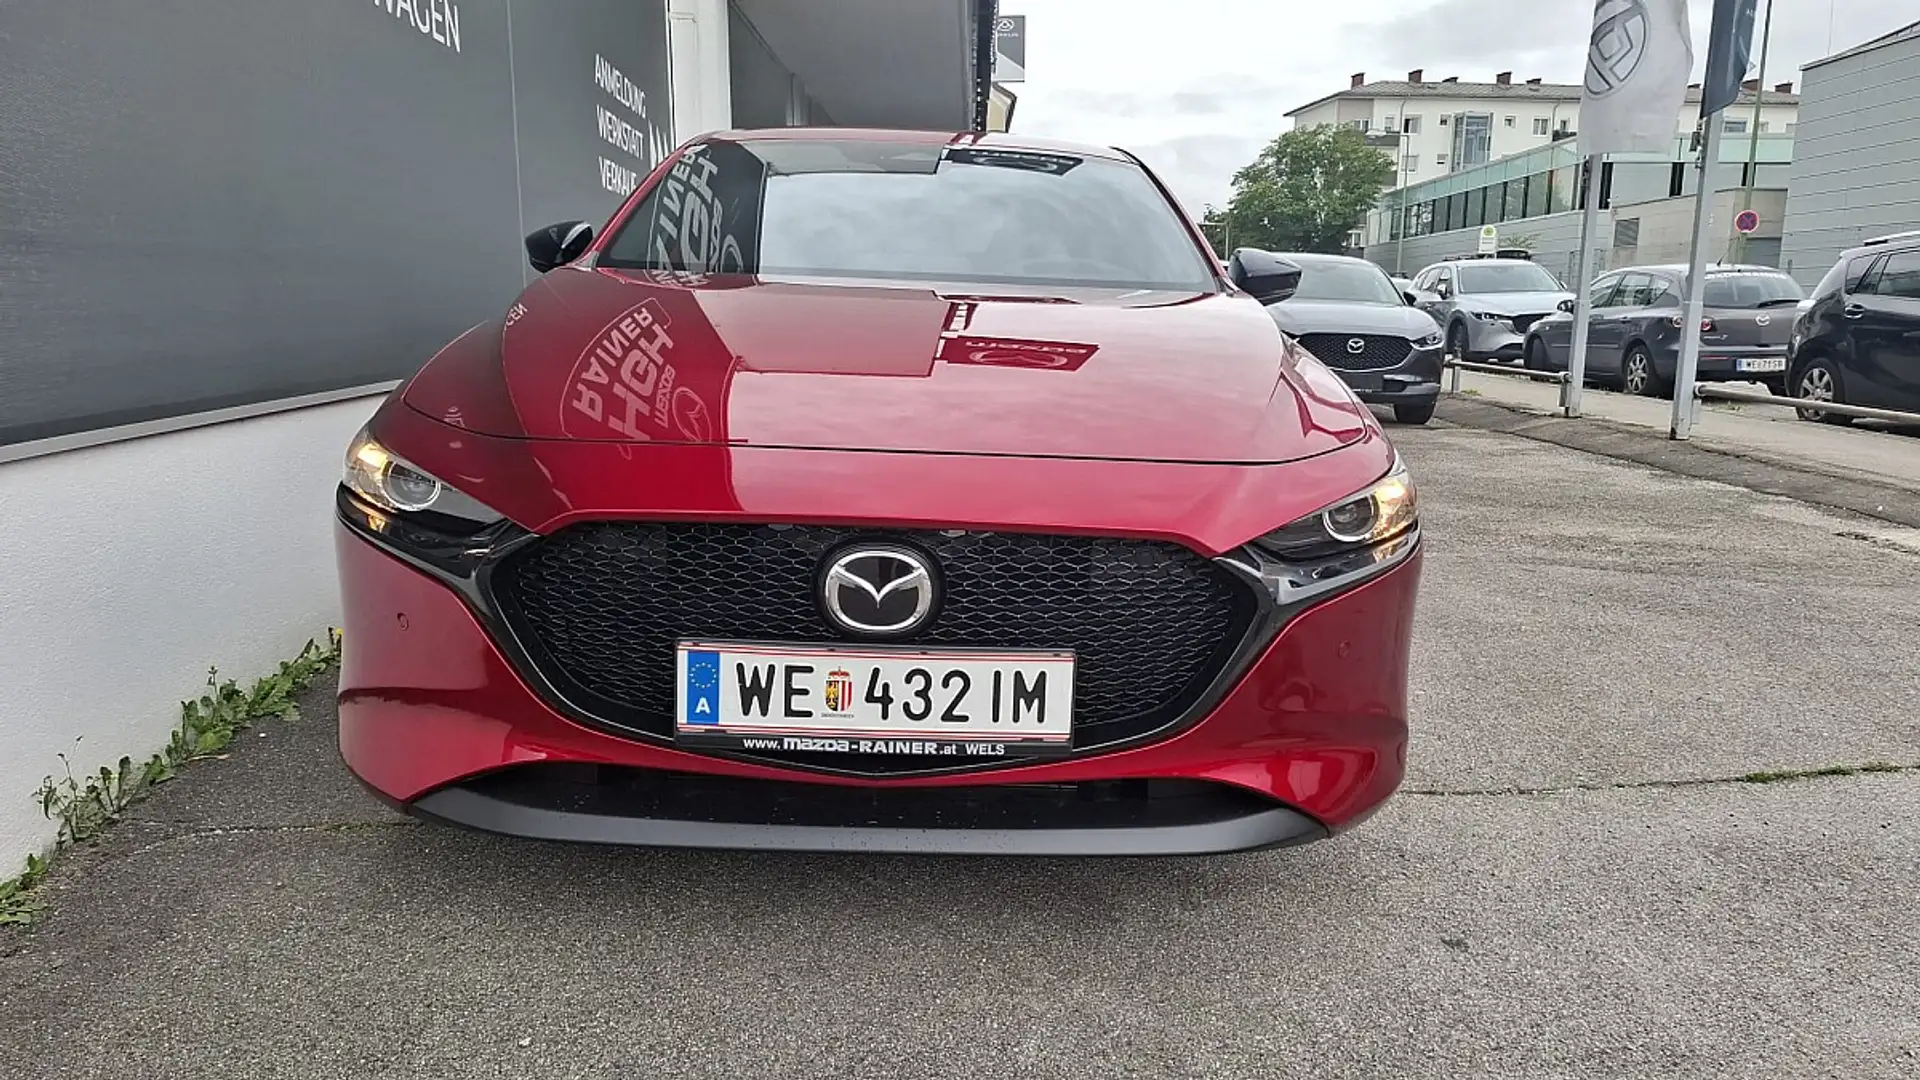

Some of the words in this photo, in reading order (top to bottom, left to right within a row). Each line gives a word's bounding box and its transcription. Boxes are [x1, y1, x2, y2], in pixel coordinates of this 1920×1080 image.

[374, 0, 461, 53] AGEN
[595, 53, 647, 119] ANMELDUNG
[596, 104, 643, 160] WERKSTATT
[694, 698, 711, 714] A
[736, 662, 814, 718] WE
[864, 667, 971, 724] 432
[992, 670, 1048, 724] IM
[965, 743, 1005, 755] WELS
